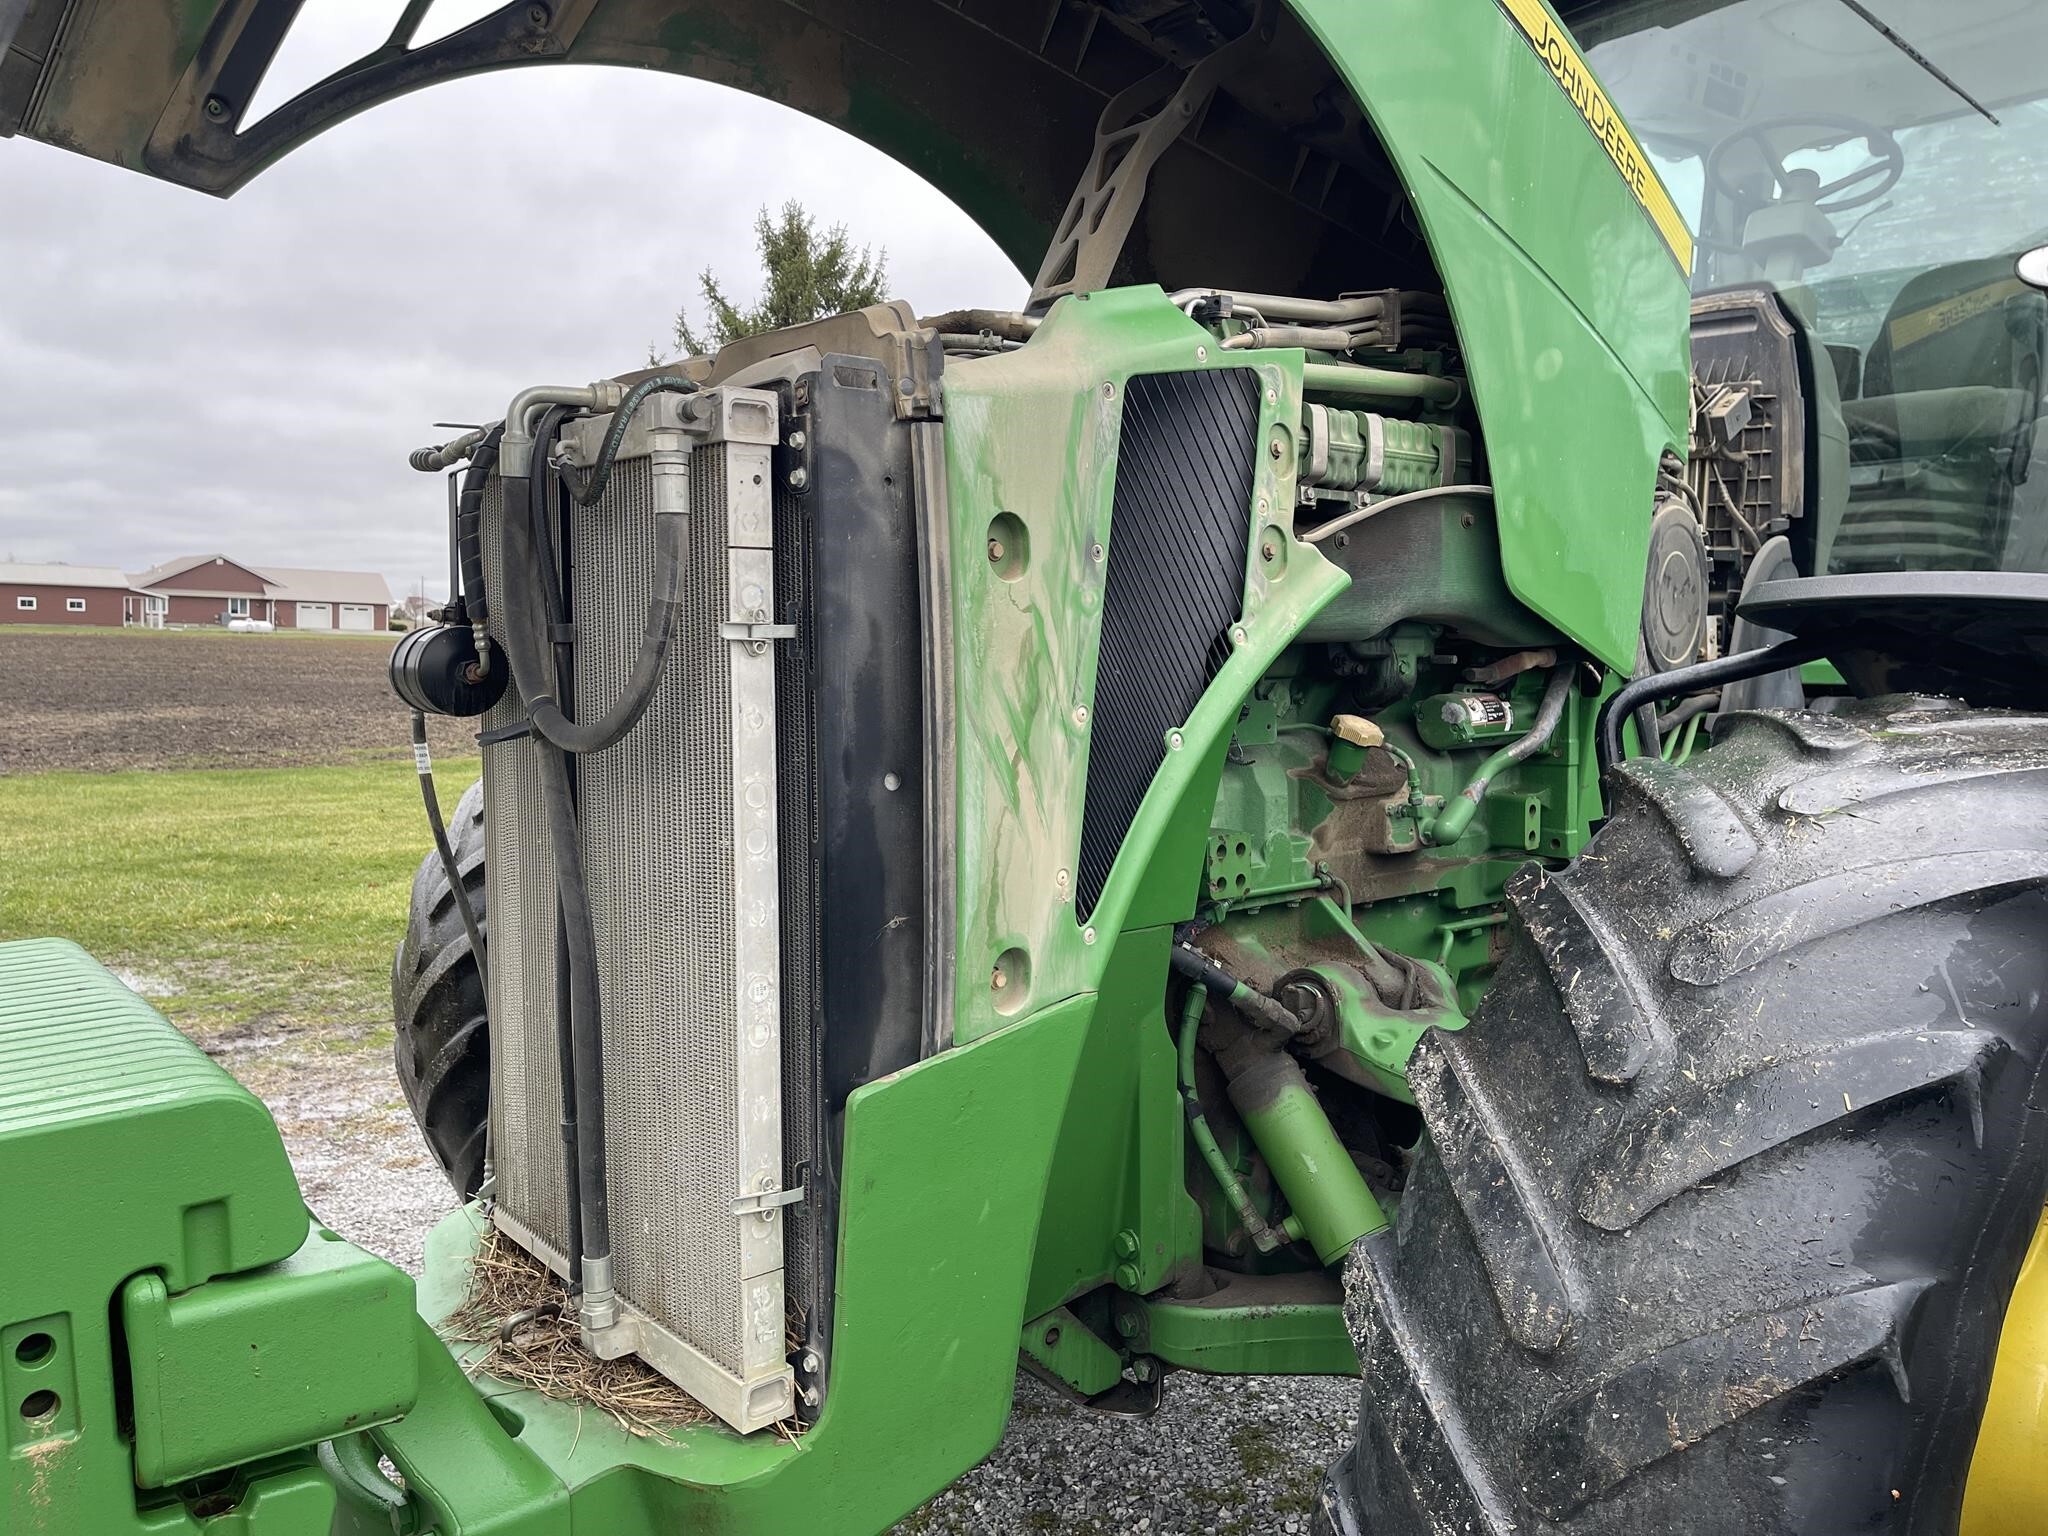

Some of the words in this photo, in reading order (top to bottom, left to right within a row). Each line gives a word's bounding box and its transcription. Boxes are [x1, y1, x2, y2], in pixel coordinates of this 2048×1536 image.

[1535, 21, 1590, 113] JOHN
[1591, 95, 1646, 199] DEERE
[611, 415, 628, 448] RATED
